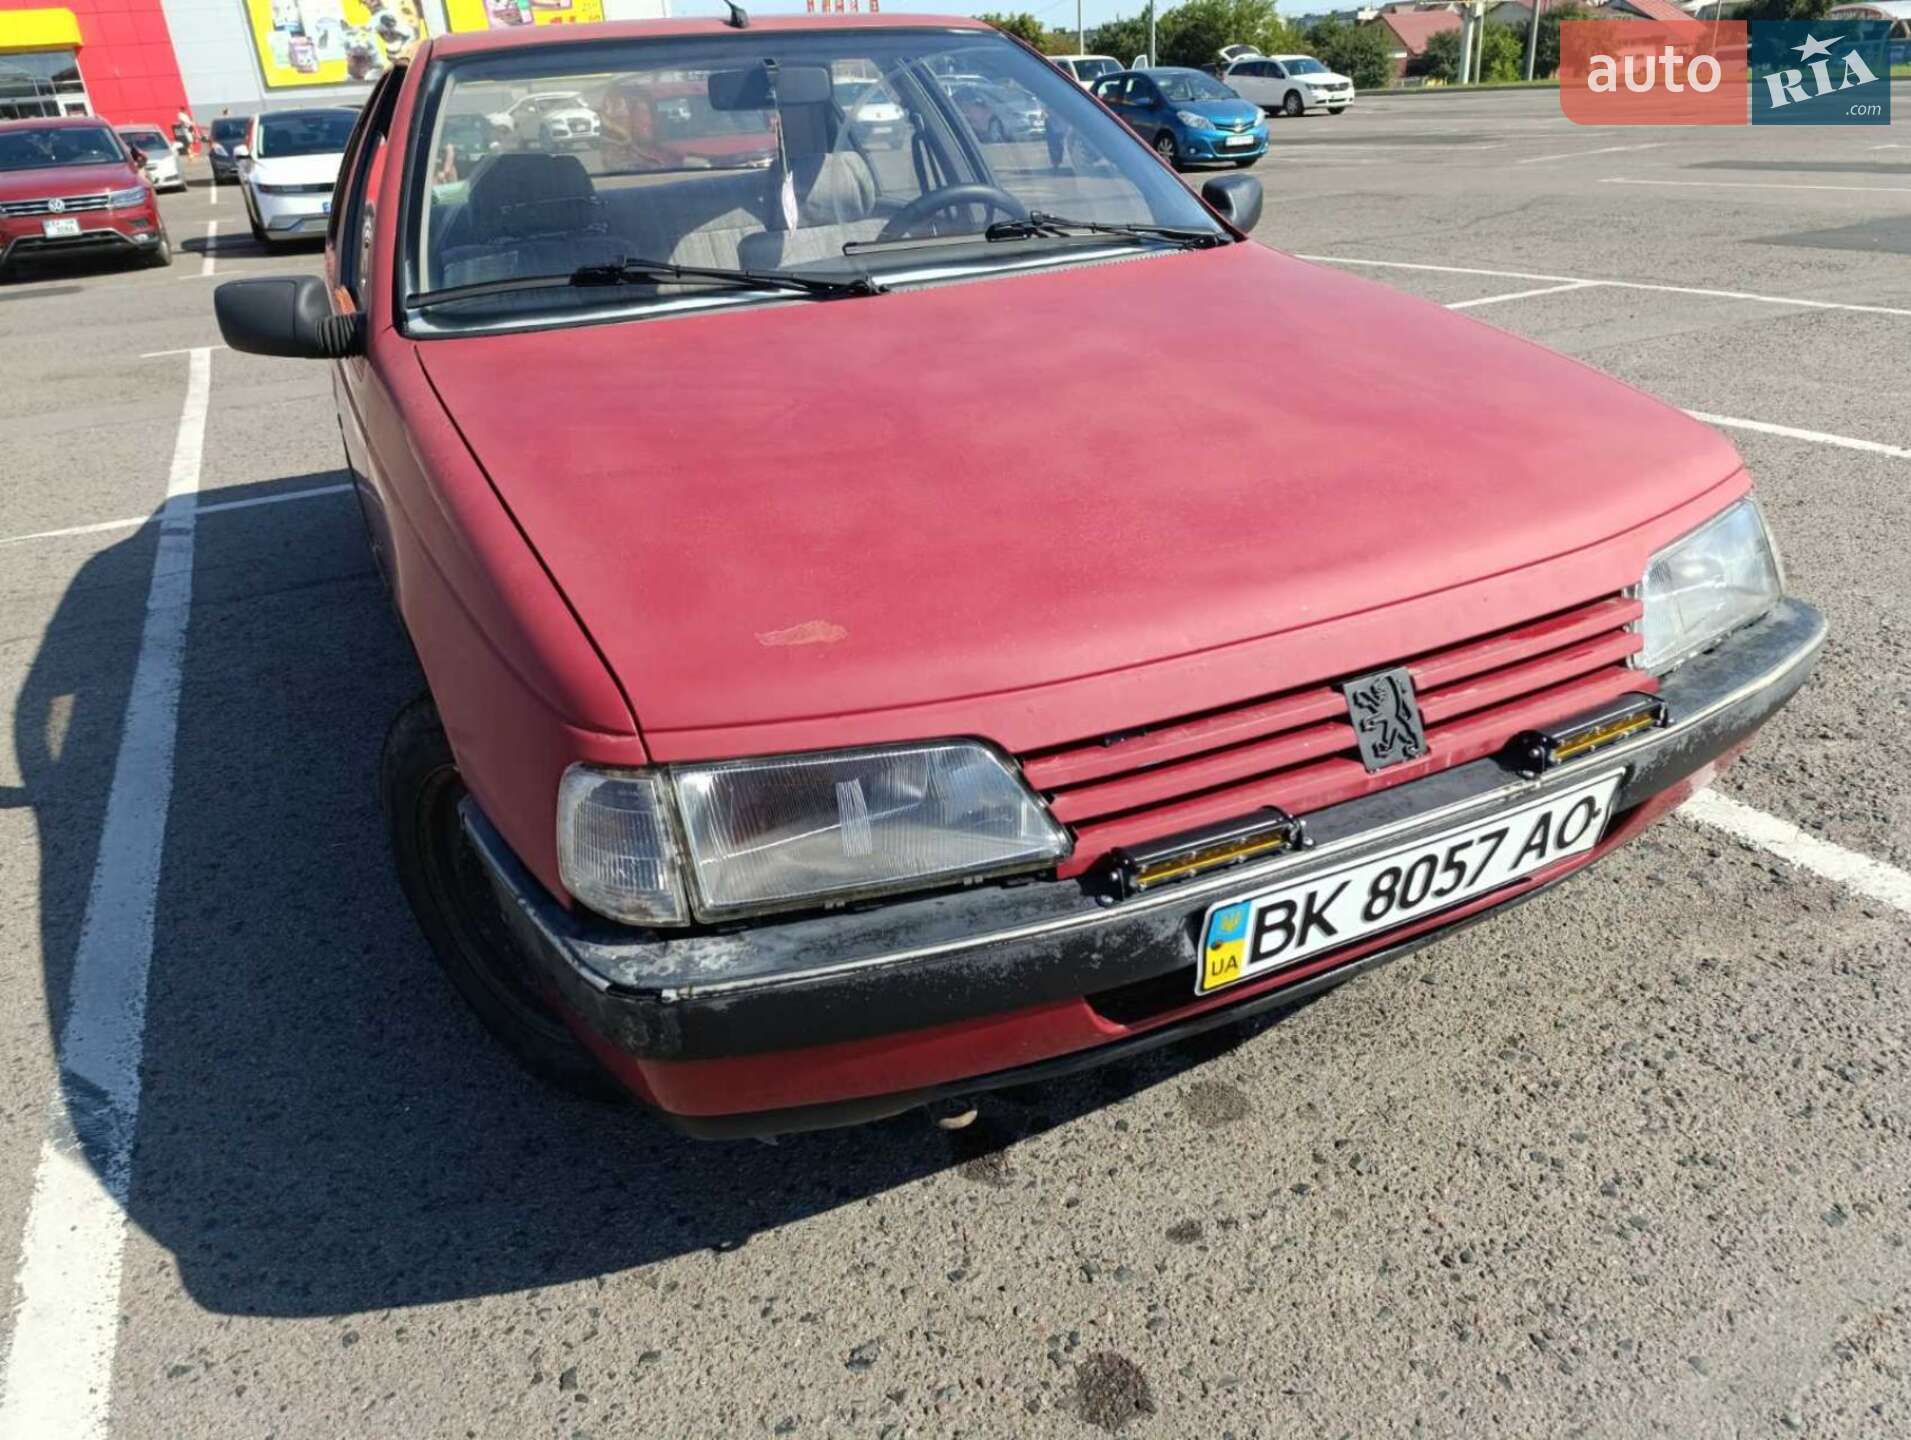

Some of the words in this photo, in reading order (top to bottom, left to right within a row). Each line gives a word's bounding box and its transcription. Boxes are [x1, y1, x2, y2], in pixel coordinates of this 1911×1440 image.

[1248, 881, 1350, 964] BK
[1361, 826, 1510, 924] 8057
[1507, 795, 1598, 871] AO
[1211, 955, 1239, 977] UA
